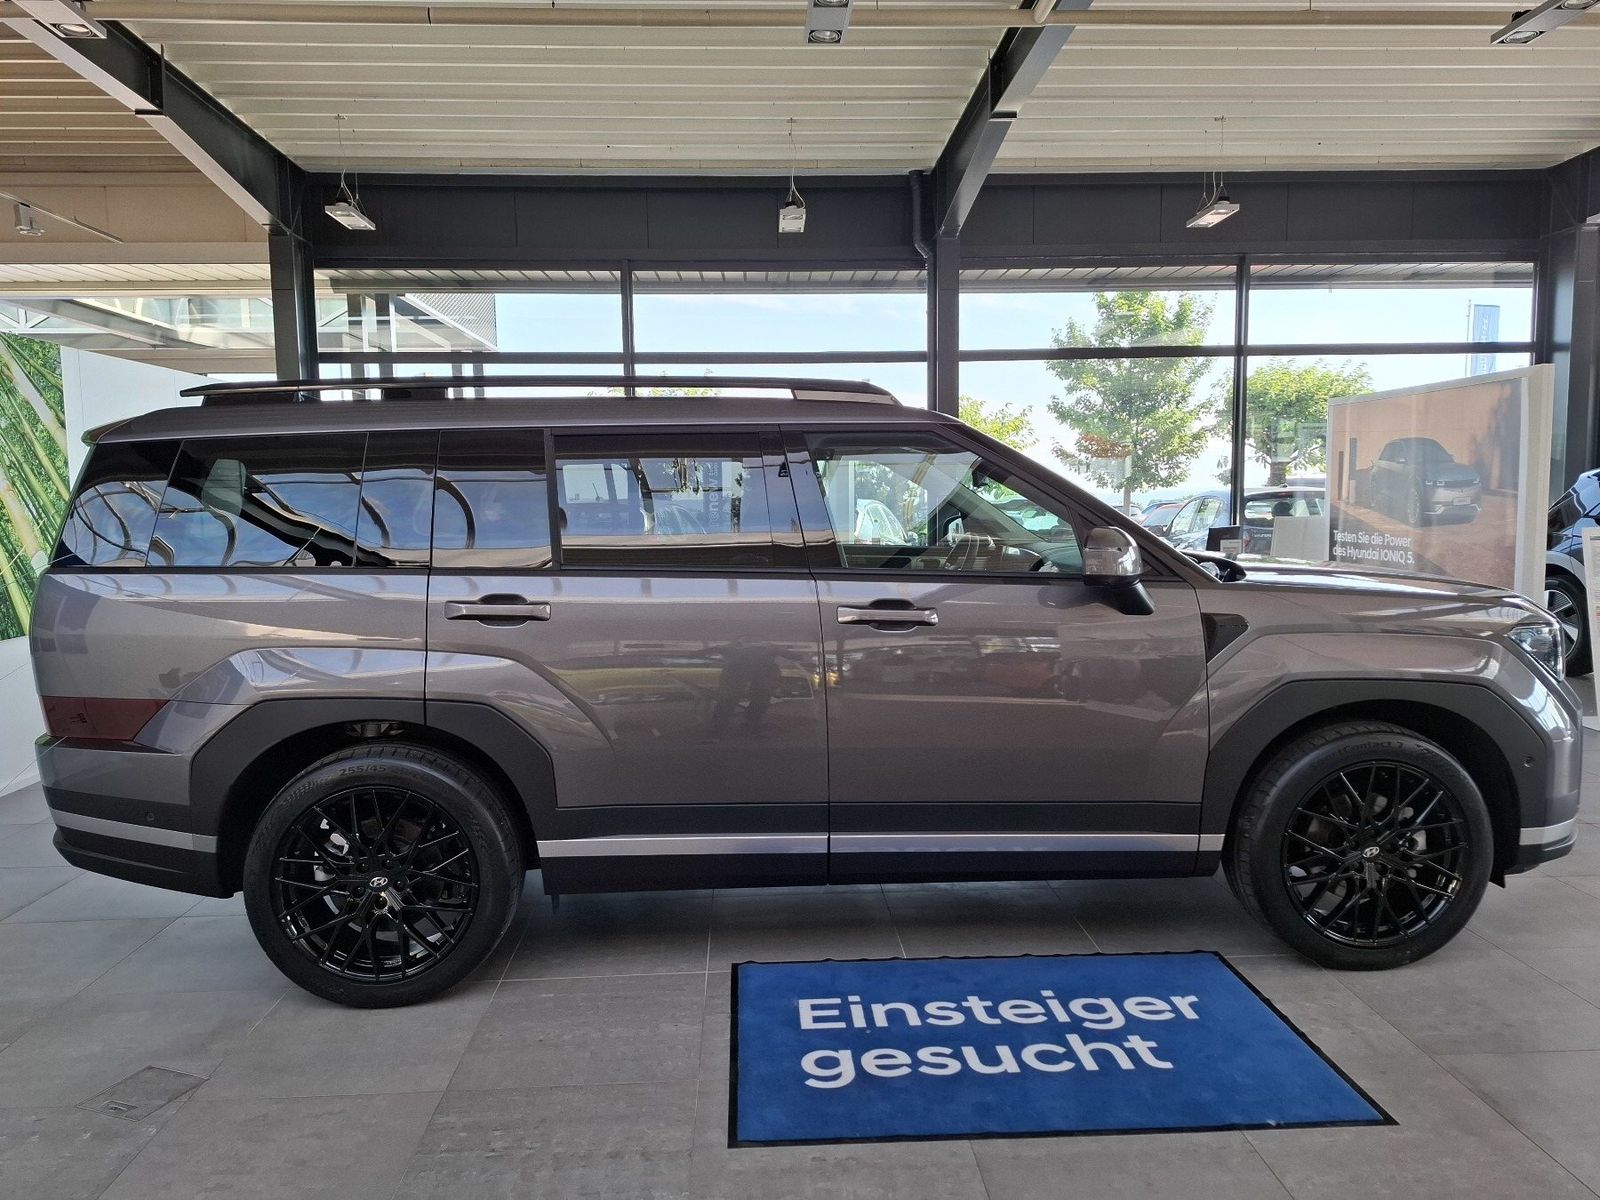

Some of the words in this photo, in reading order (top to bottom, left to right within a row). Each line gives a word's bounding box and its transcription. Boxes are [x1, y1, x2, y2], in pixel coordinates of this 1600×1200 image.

[1333, 530, 1357, 543] Testen
[1358, 531, 1370, 544] Sie
[1371, 532, 1384, 545] die
[1384, 534, 1412, 547] Power
[1333, 544, 1346, 556] des
[1347, 546, 1380, 560] Hyundai
[1380, 549, 1406, 565] IONIQ
[1407, 551, 1415, 565] 5.
[339, 764, 387, 776] 255/45
[799, 990, 1200, 1030] Einsteiger
[800, 1033, 1174, 1090] gesucht
